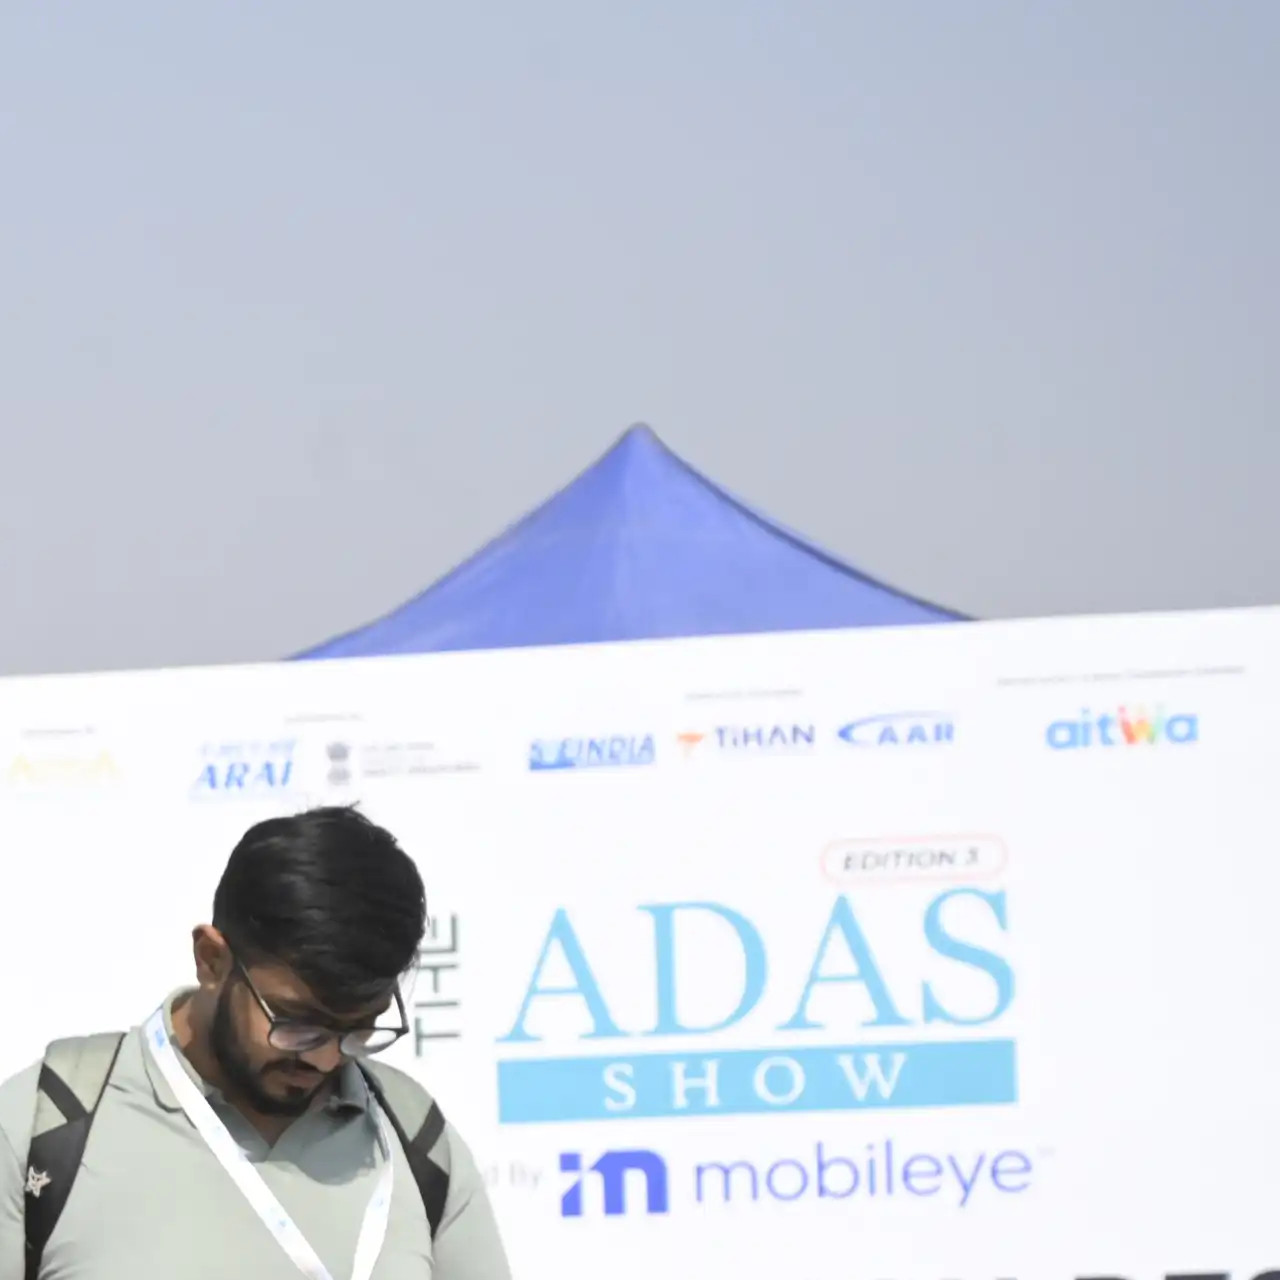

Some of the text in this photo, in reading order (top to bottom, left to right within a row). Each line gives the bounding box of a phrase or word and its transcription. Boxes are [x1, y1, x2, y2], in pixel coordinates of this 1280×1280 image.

[844, 850, 957, 872] EDITION
[495, 887, 1017, 1043] ADAS
[603, 1053, 907, 1111] SHOW
[695, 1138, 1033, 1207] mobileye
